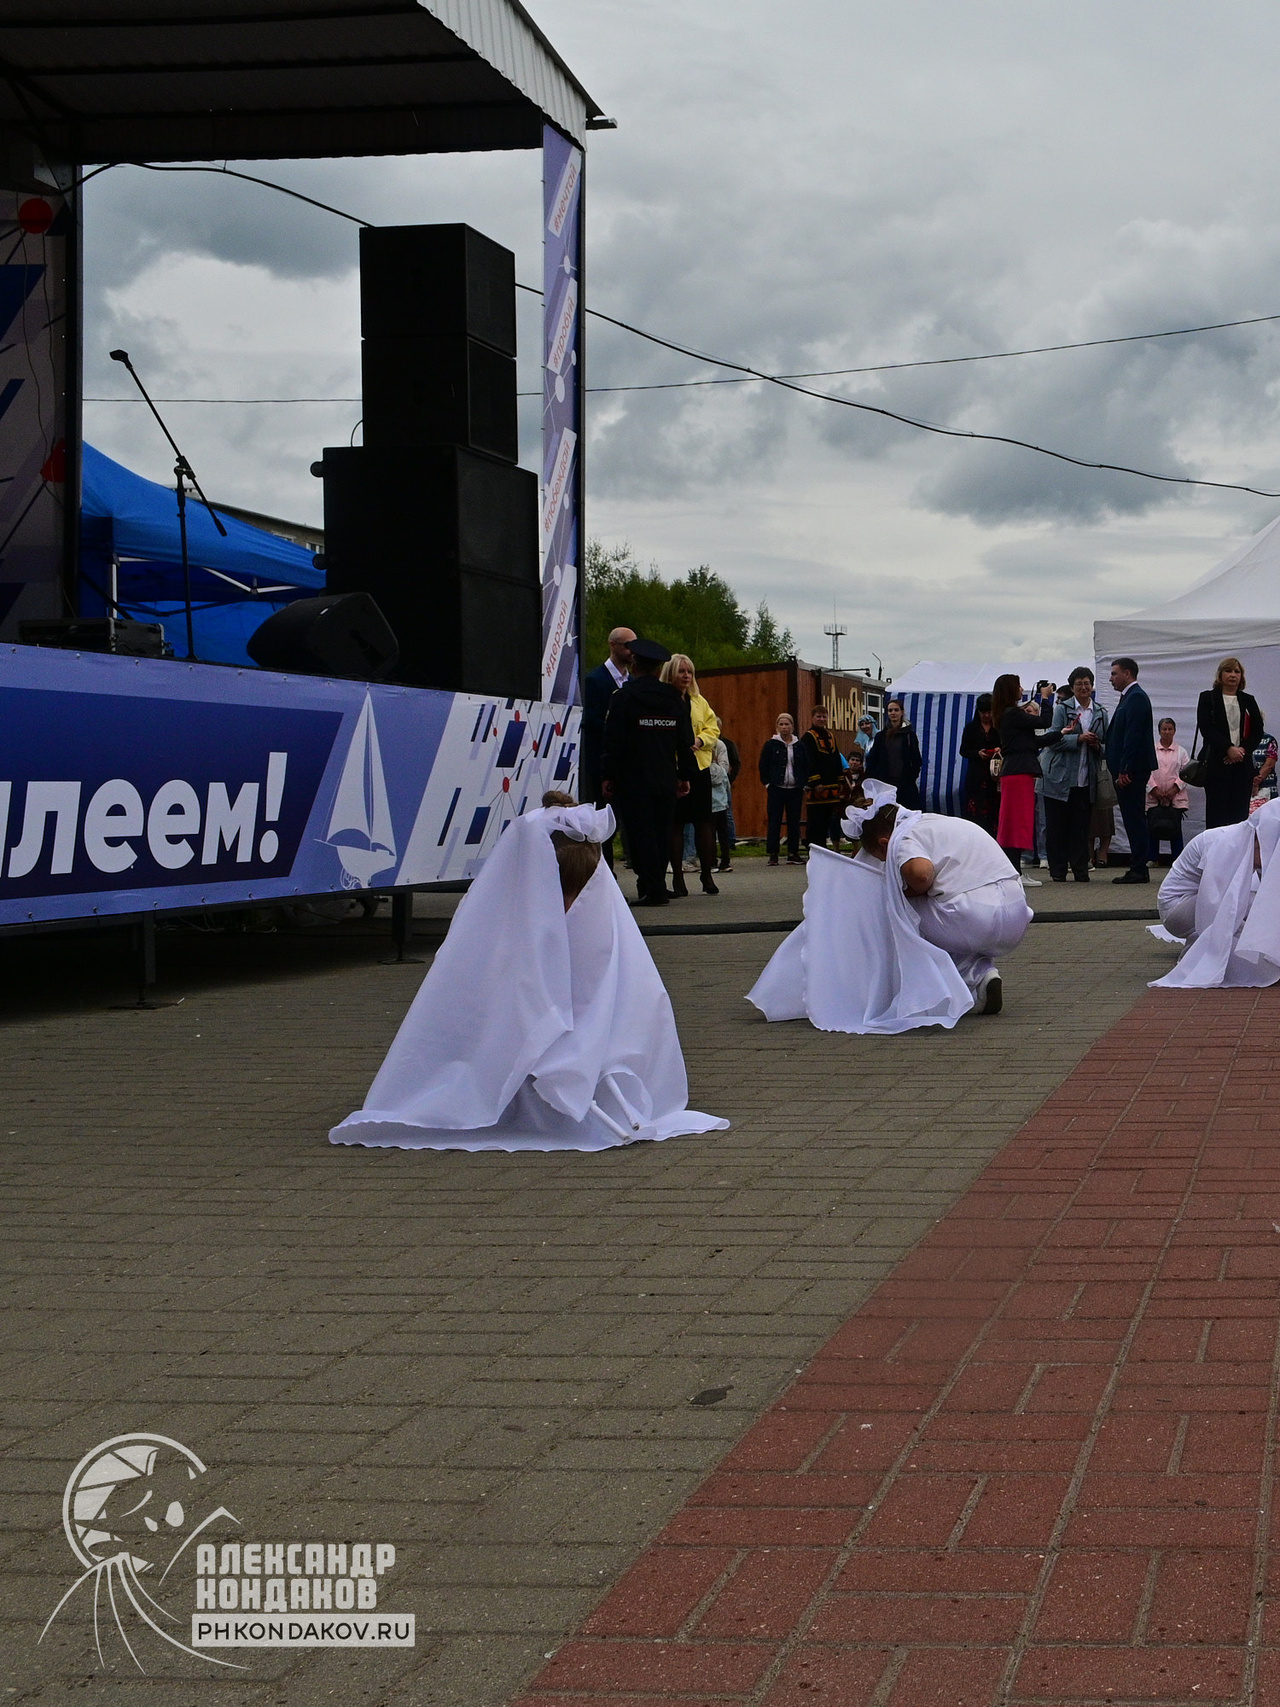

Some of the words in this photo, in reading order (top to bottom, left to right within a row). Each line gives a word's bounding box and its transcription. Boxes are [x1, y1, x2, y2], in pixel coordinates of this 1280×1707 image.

[553, 162, 577, 232] #мечтай
[552, 296, 576, 369] #пробуй
[543, 439, 571, 533] #побеждай
[545, 598, 569, 678] #дерзай
[639, 718, 654, 727] МВД
[654, 719, 677, 727] РОССИИ
[0, 751, 288, 878] леем!
